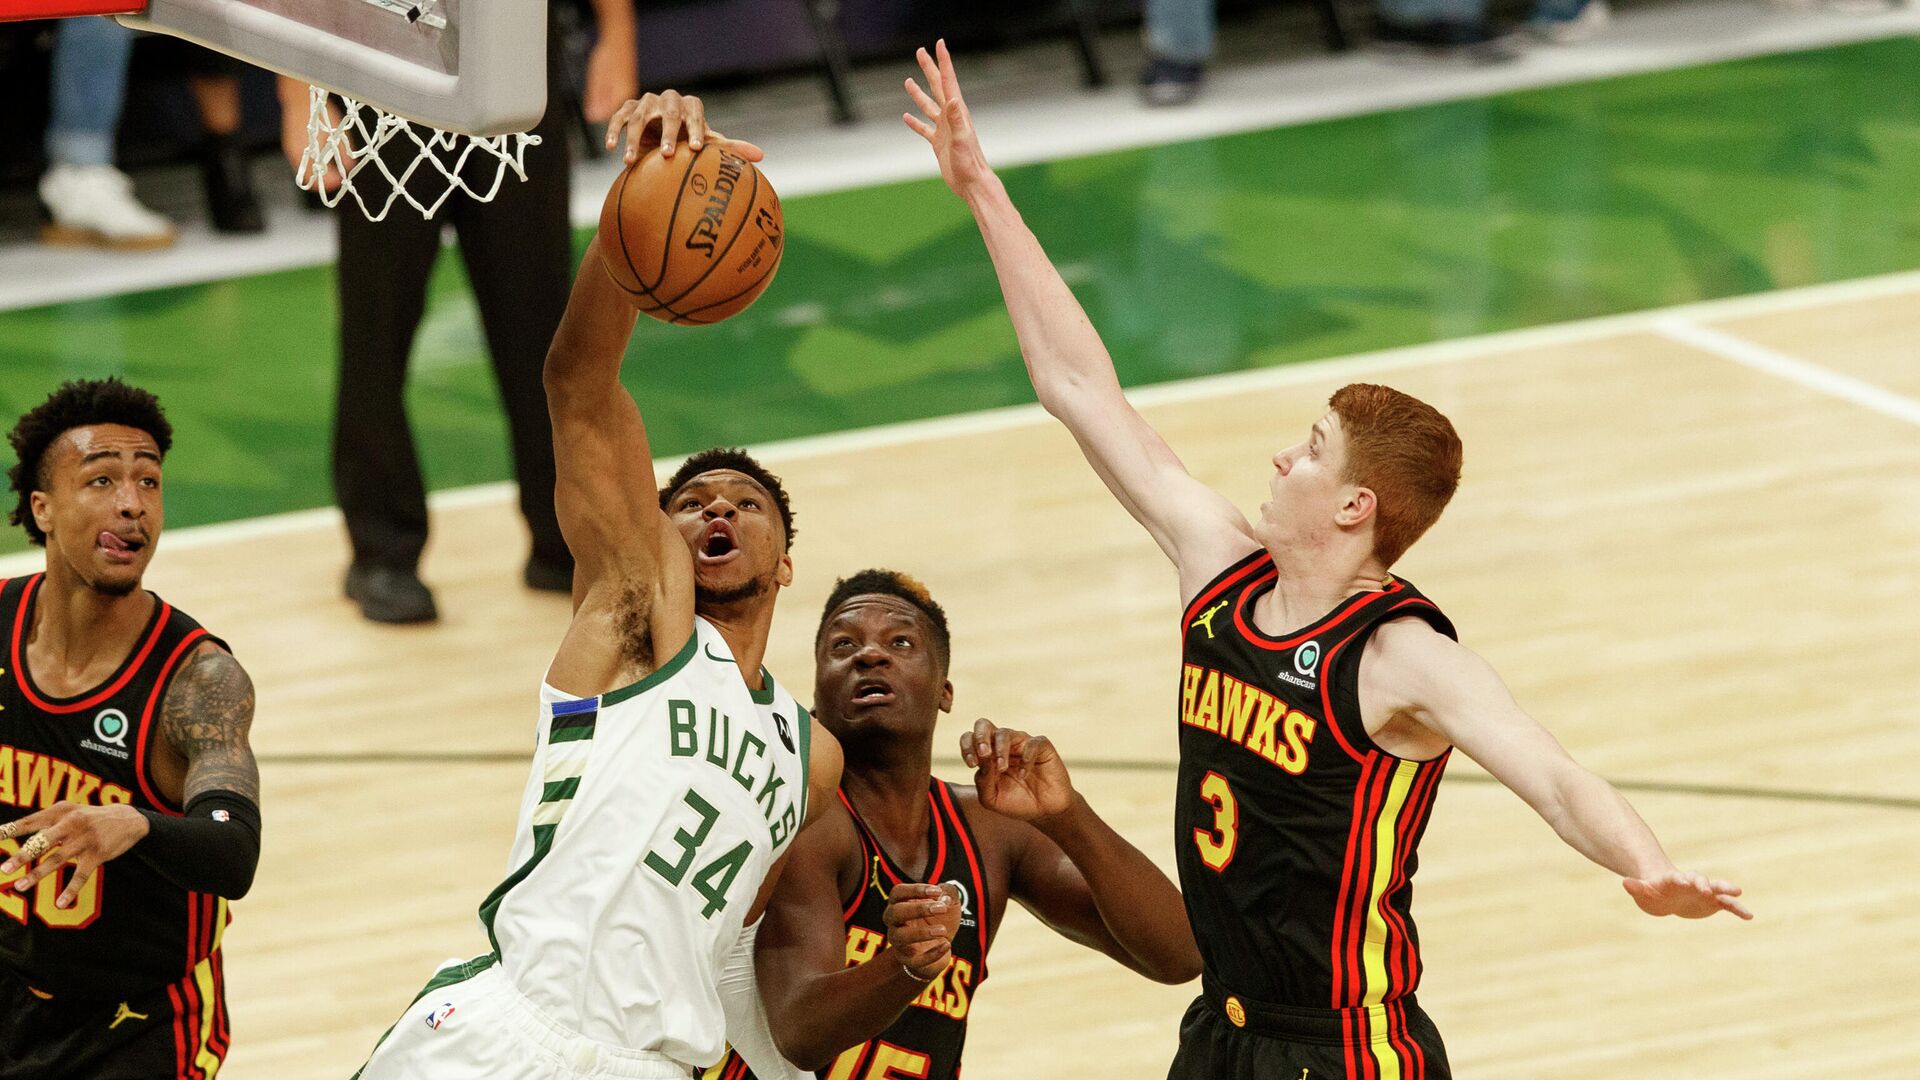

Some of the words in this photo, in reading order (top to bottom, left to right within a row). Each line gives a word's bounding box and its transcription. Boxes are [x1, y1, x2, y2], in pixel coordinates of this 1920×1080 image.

[686, 149, 747, 259] SPALDING
[1181, 662, 1318, 776] HAWKS
[1277, 671, 1316, 690] sharecare
[80, 738, 129, 760] sharecare
[667, 699, 796, 850] BUCKS
[643, 787, 754, 920] 34
[1193, 769, 1239, 873] 3
[845, 924, 973, 1021] HKS
